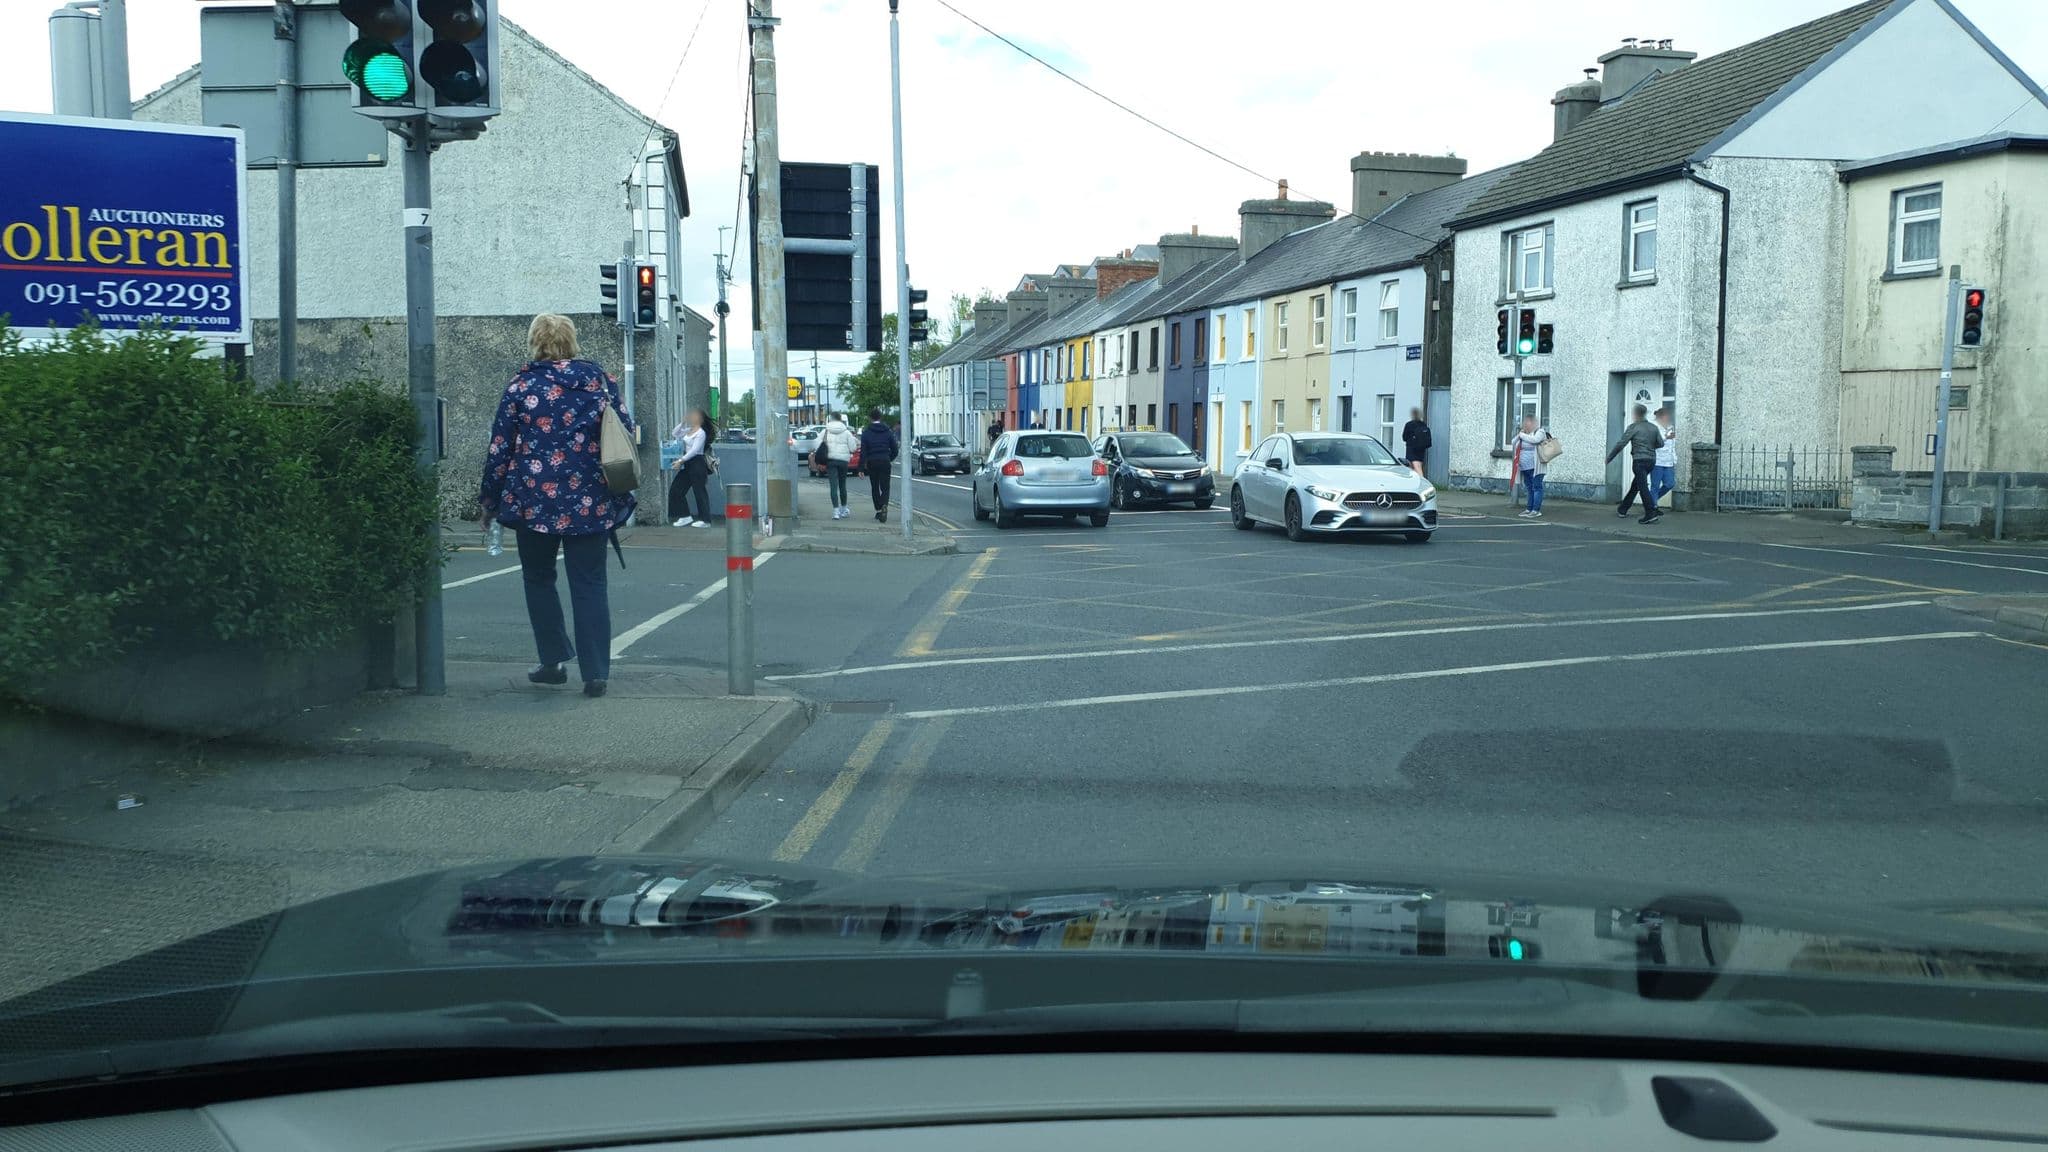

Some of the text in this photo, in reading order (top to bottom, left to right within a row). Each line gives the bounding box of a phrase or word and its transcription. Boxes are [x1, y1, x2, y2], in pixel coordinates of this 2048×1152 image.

[88, 208, 225, 228] AUCTIONEERS
[421, 213, 429, 225] 7
[0, 204, 232, 268] olleran
[24, 280, 231, 311] 091-562293
